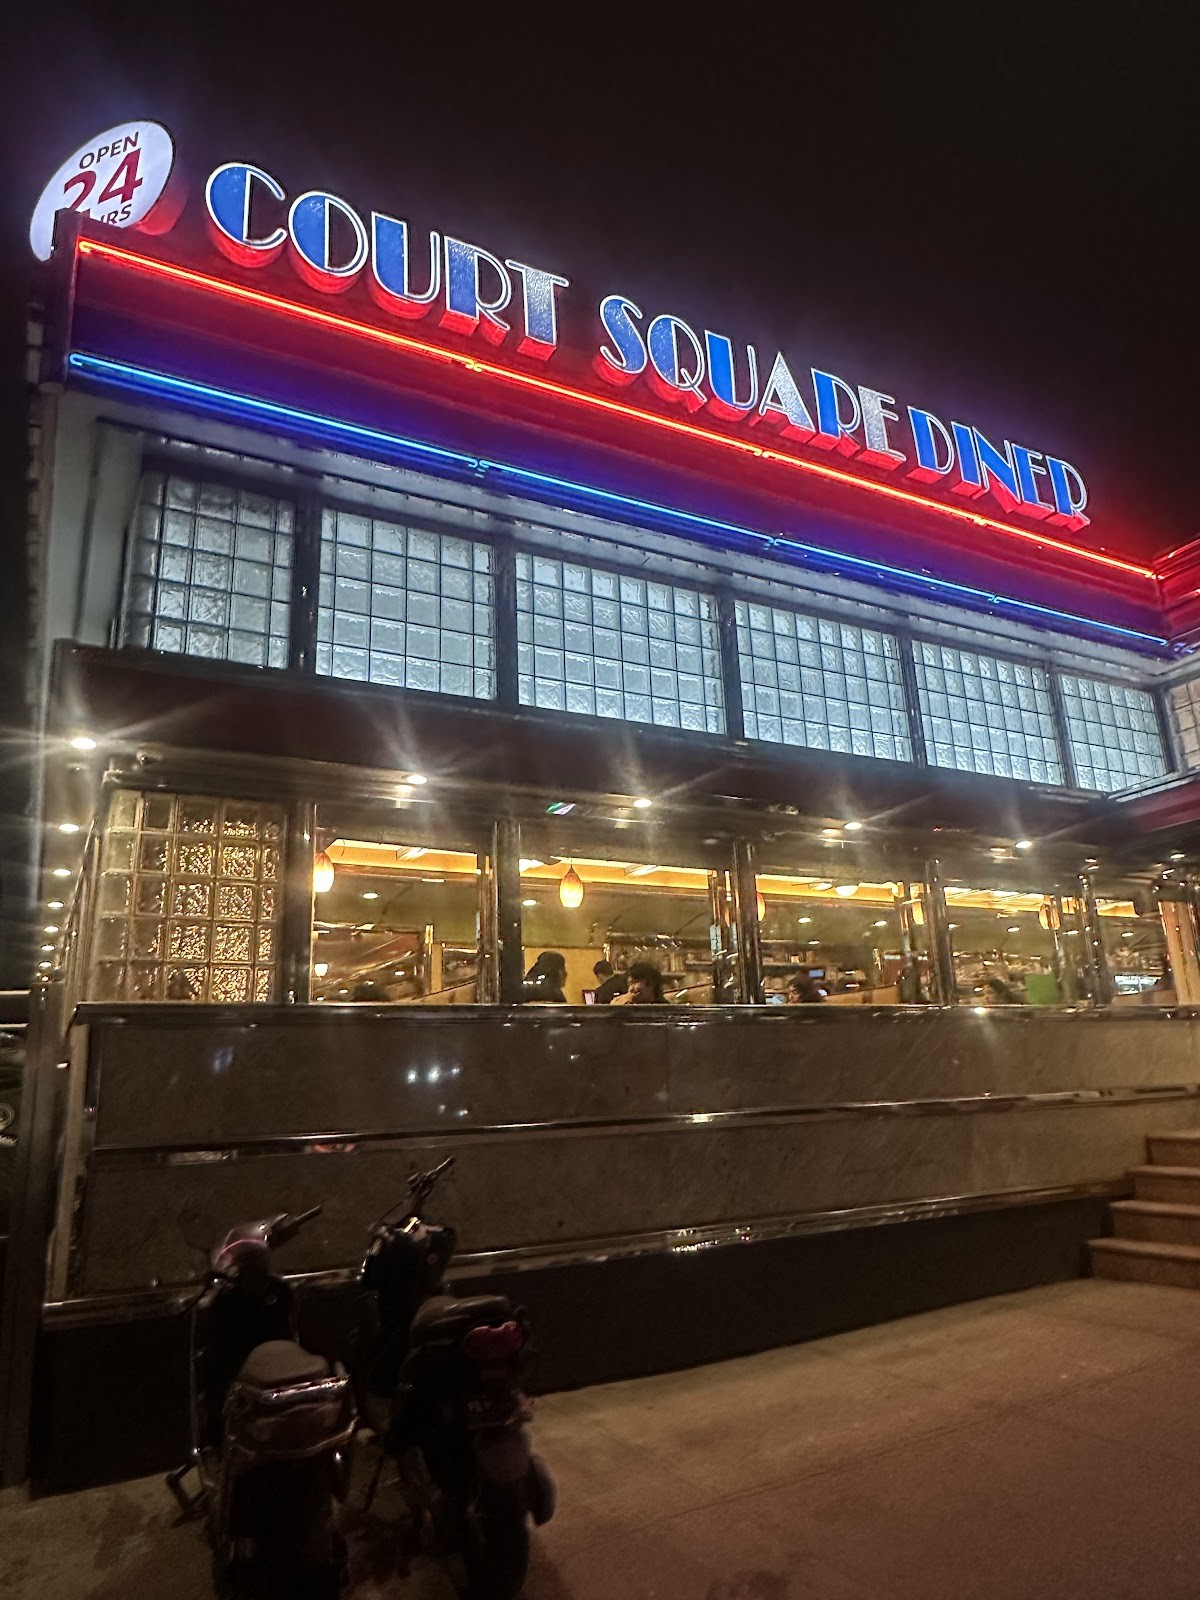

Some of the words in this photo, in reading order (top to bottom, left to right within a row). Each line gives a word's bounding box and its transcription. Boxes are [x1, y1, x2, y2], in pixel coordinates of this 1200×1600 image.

[63, 148, 143, 209] 24
[79, 132, 139, 169] OPEN
[205, 162, 570, 346] COURT
[599, 295, 906, 462] SQUARE
[907, 405, 1091, 526] DINER
